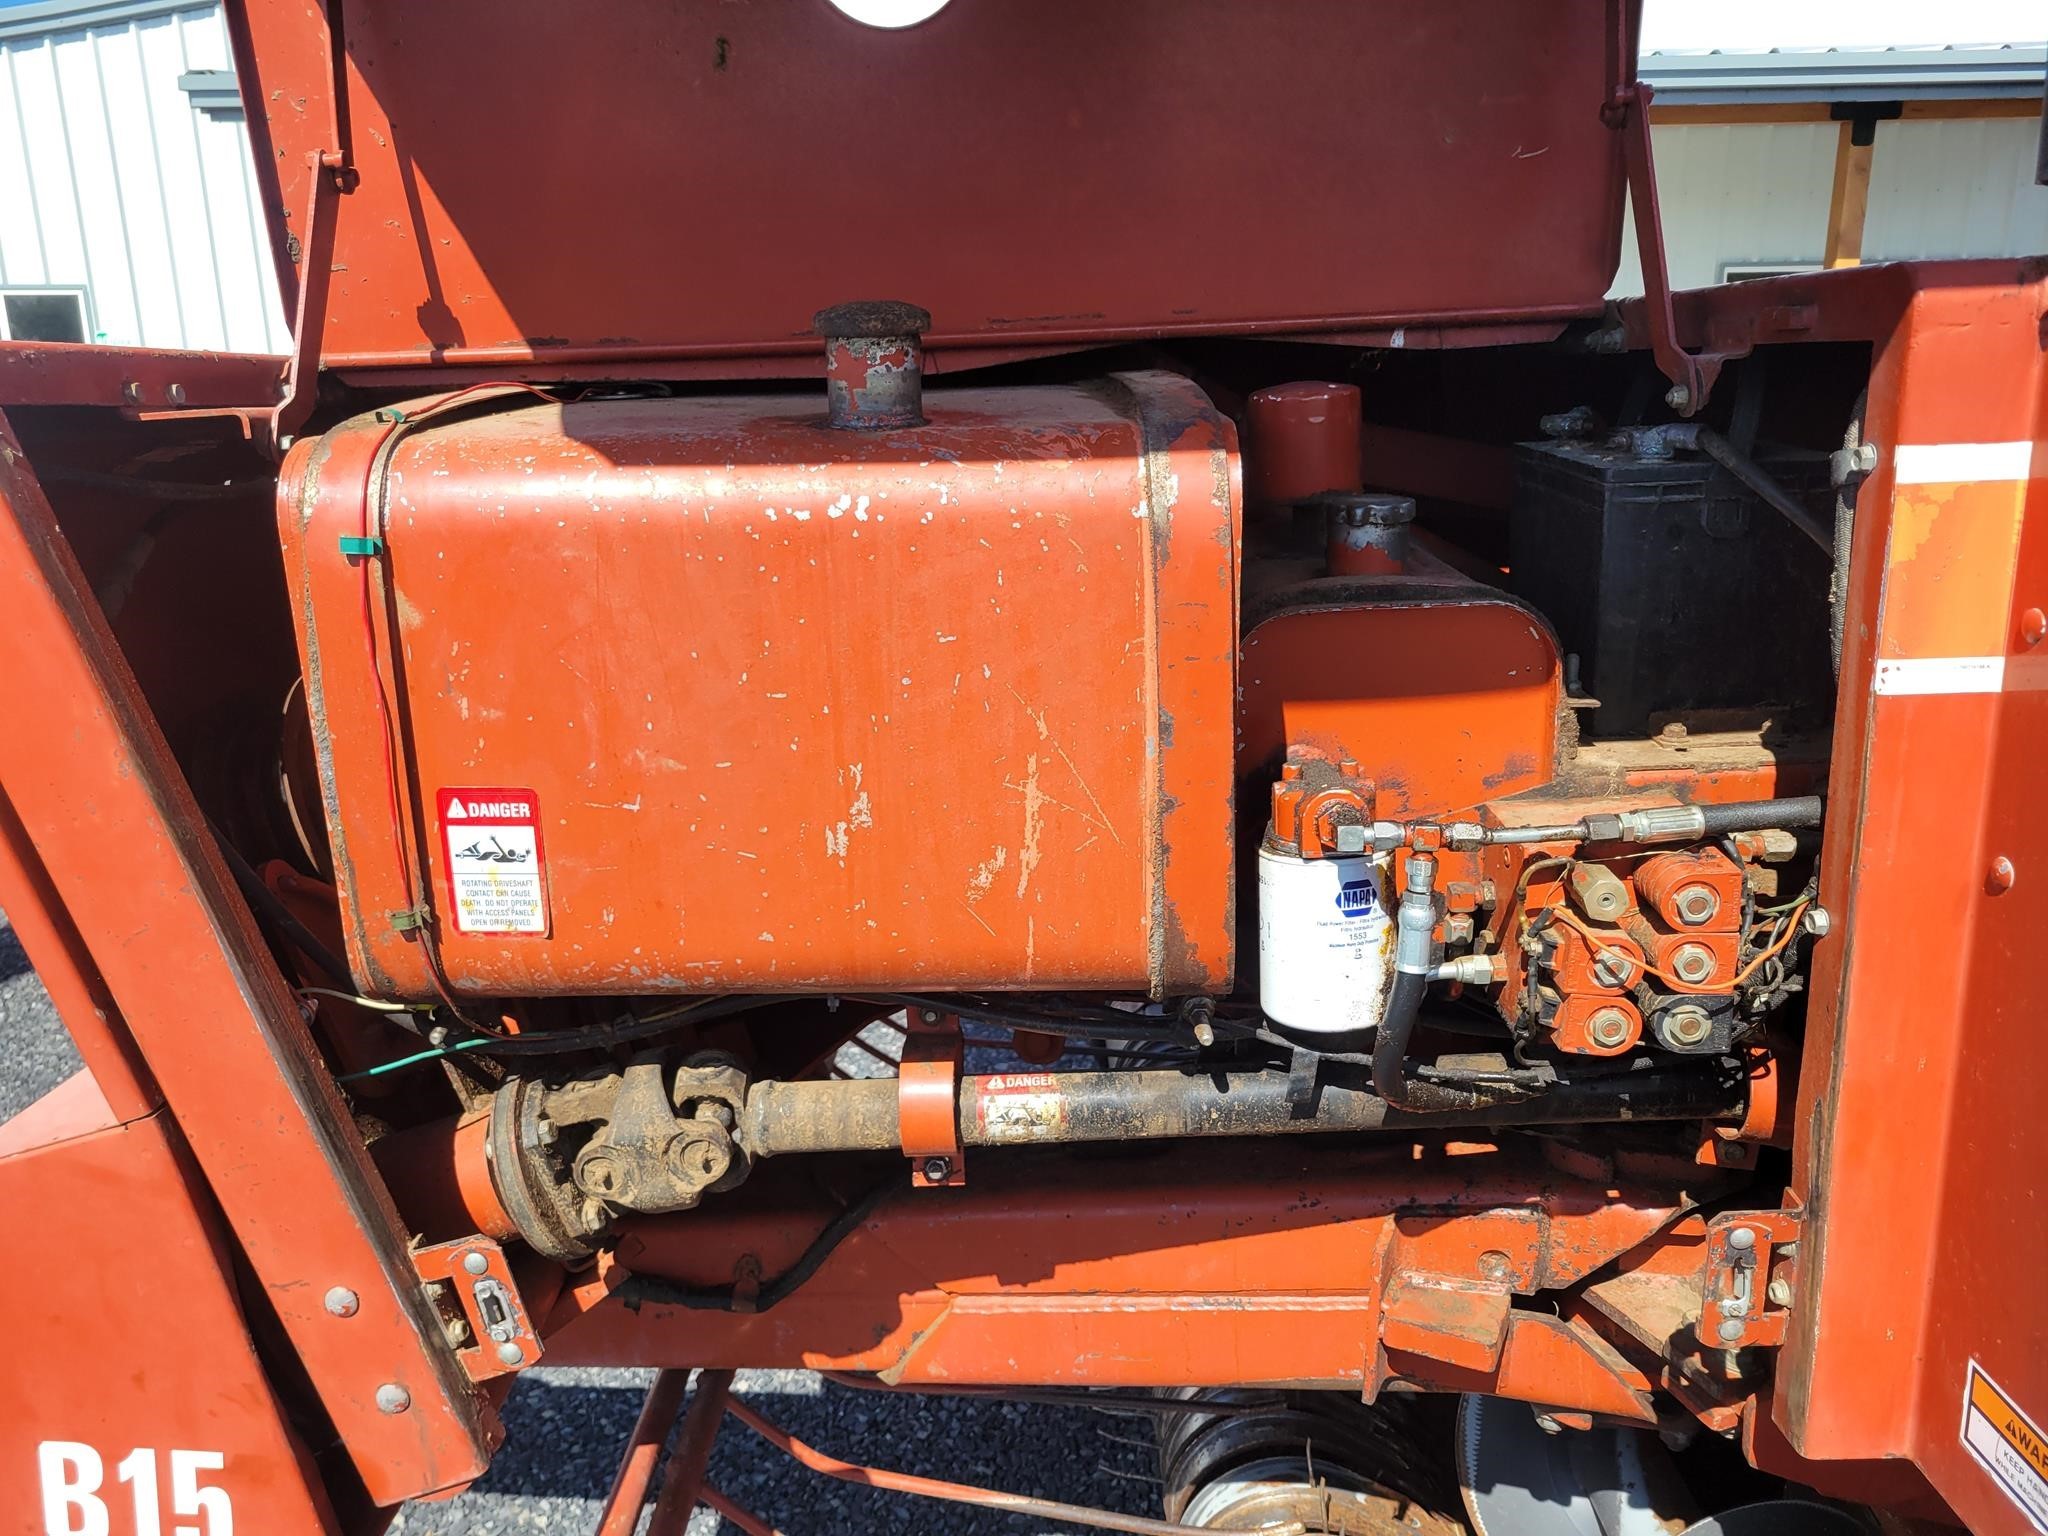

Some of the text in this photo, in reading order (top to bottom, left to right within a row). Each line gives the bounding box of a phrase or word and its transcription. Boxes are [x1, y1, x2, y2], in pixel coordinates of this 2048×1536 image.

[468, 803, 531, 818] DANGER
[1343, 888, 1371, 910] NAPA
[470, 918, 488, 926] OPEN
[490, 918, 499, 926] OR
[1349, 931, 1367, 941] 1553
[1006, 1076, 1057, 1088] DANGER
[1995, 1457, 2016, 1482] WHILE
[2003, 1449, 2024, 1475] KEEP
[38, 1440, 234, 1536] B15
